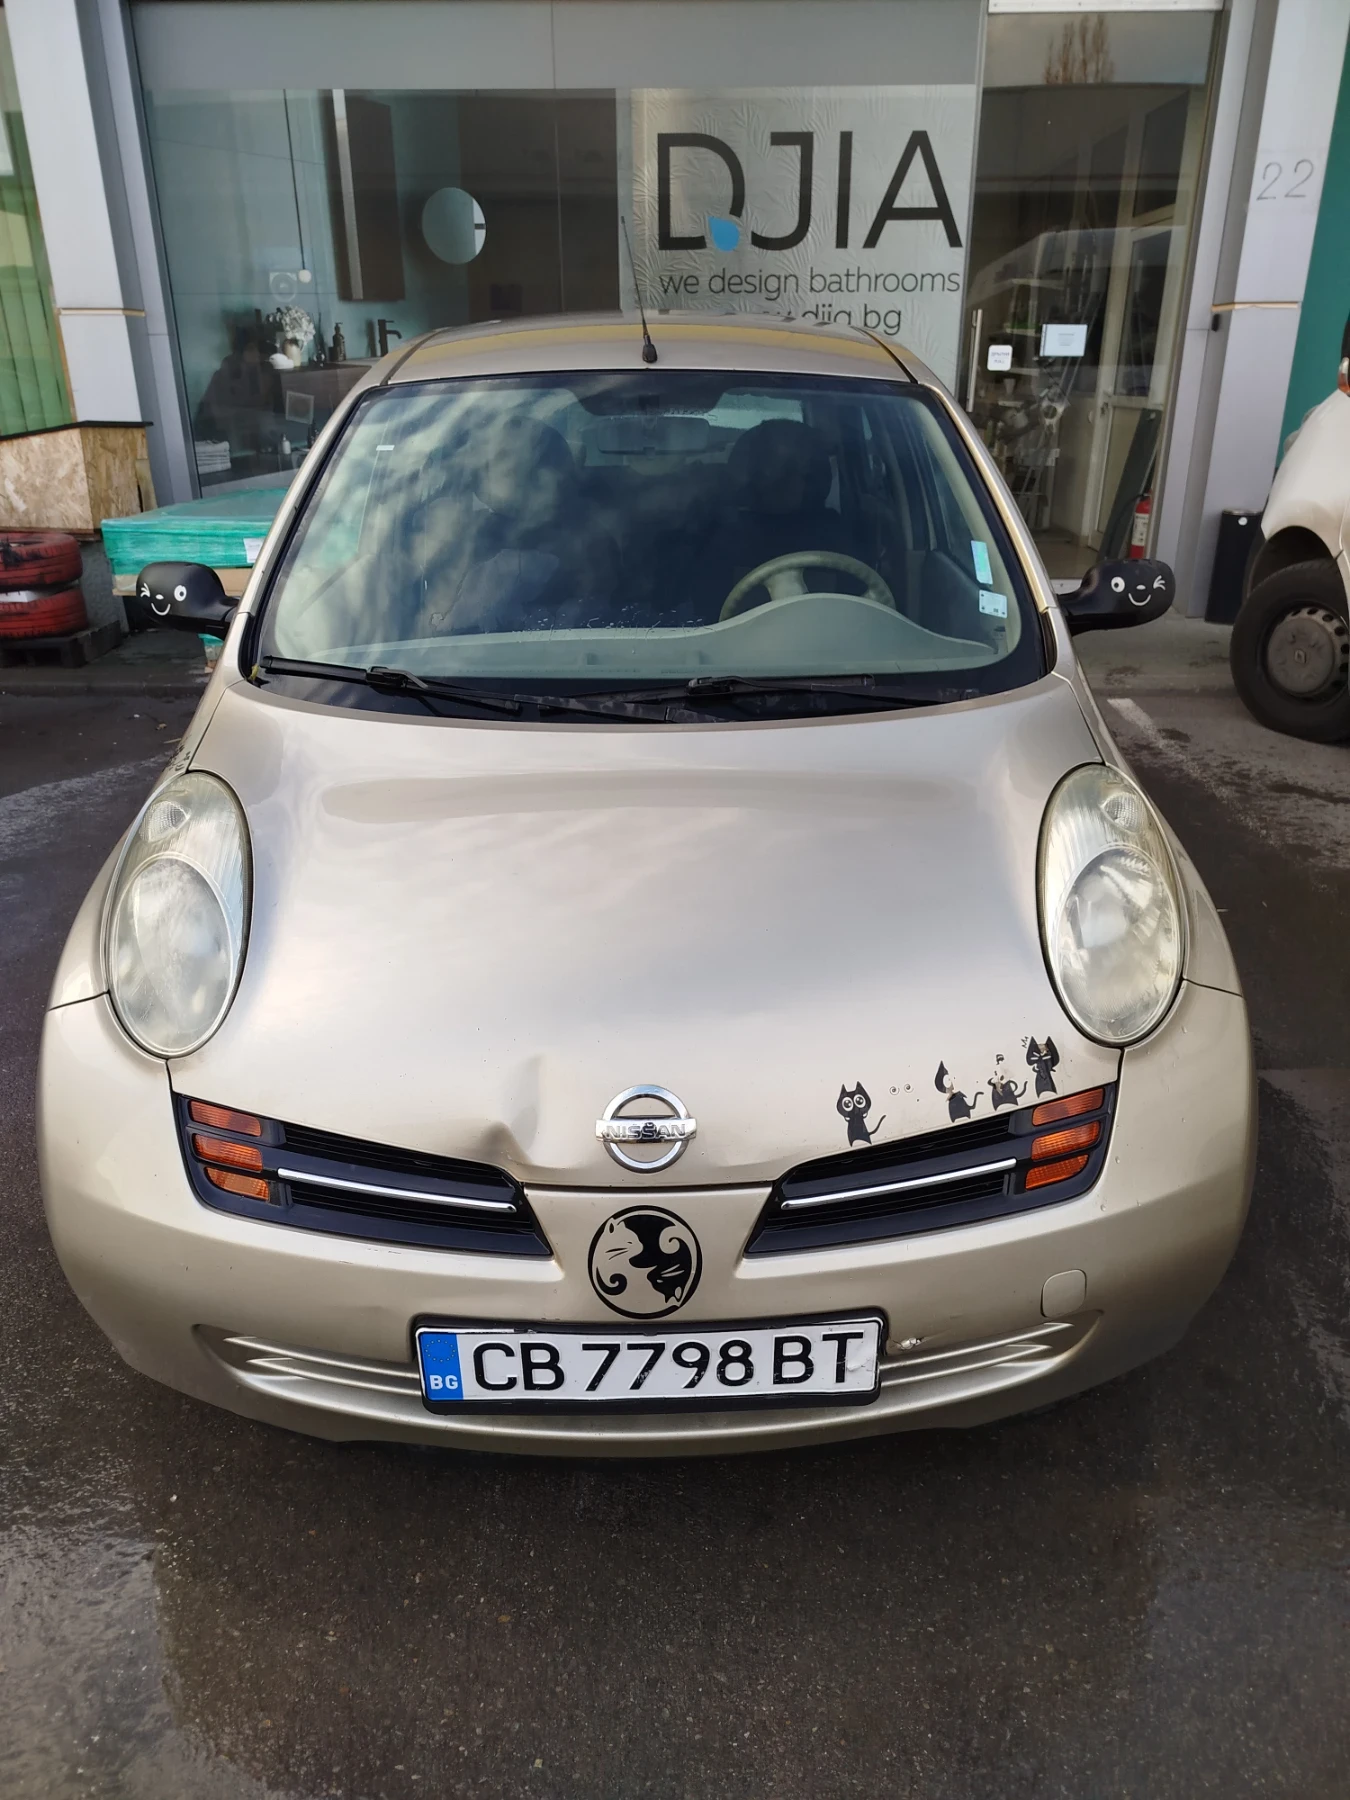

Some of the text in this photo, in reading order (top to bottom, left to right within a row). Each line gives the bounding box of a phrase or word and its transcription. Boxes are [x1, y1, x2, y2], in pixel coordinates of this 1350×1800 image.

[657, 130, 963, 251] DJIA
[1256, 158, 1314, 201] 22
[659, 266, 961, 301] we design bathrooms
[605, 1122, 686, 1139] NISSAN
[472, 1331, 865, 1392] CB 7798 BT
[430, 1375, 459, 1391] BG
